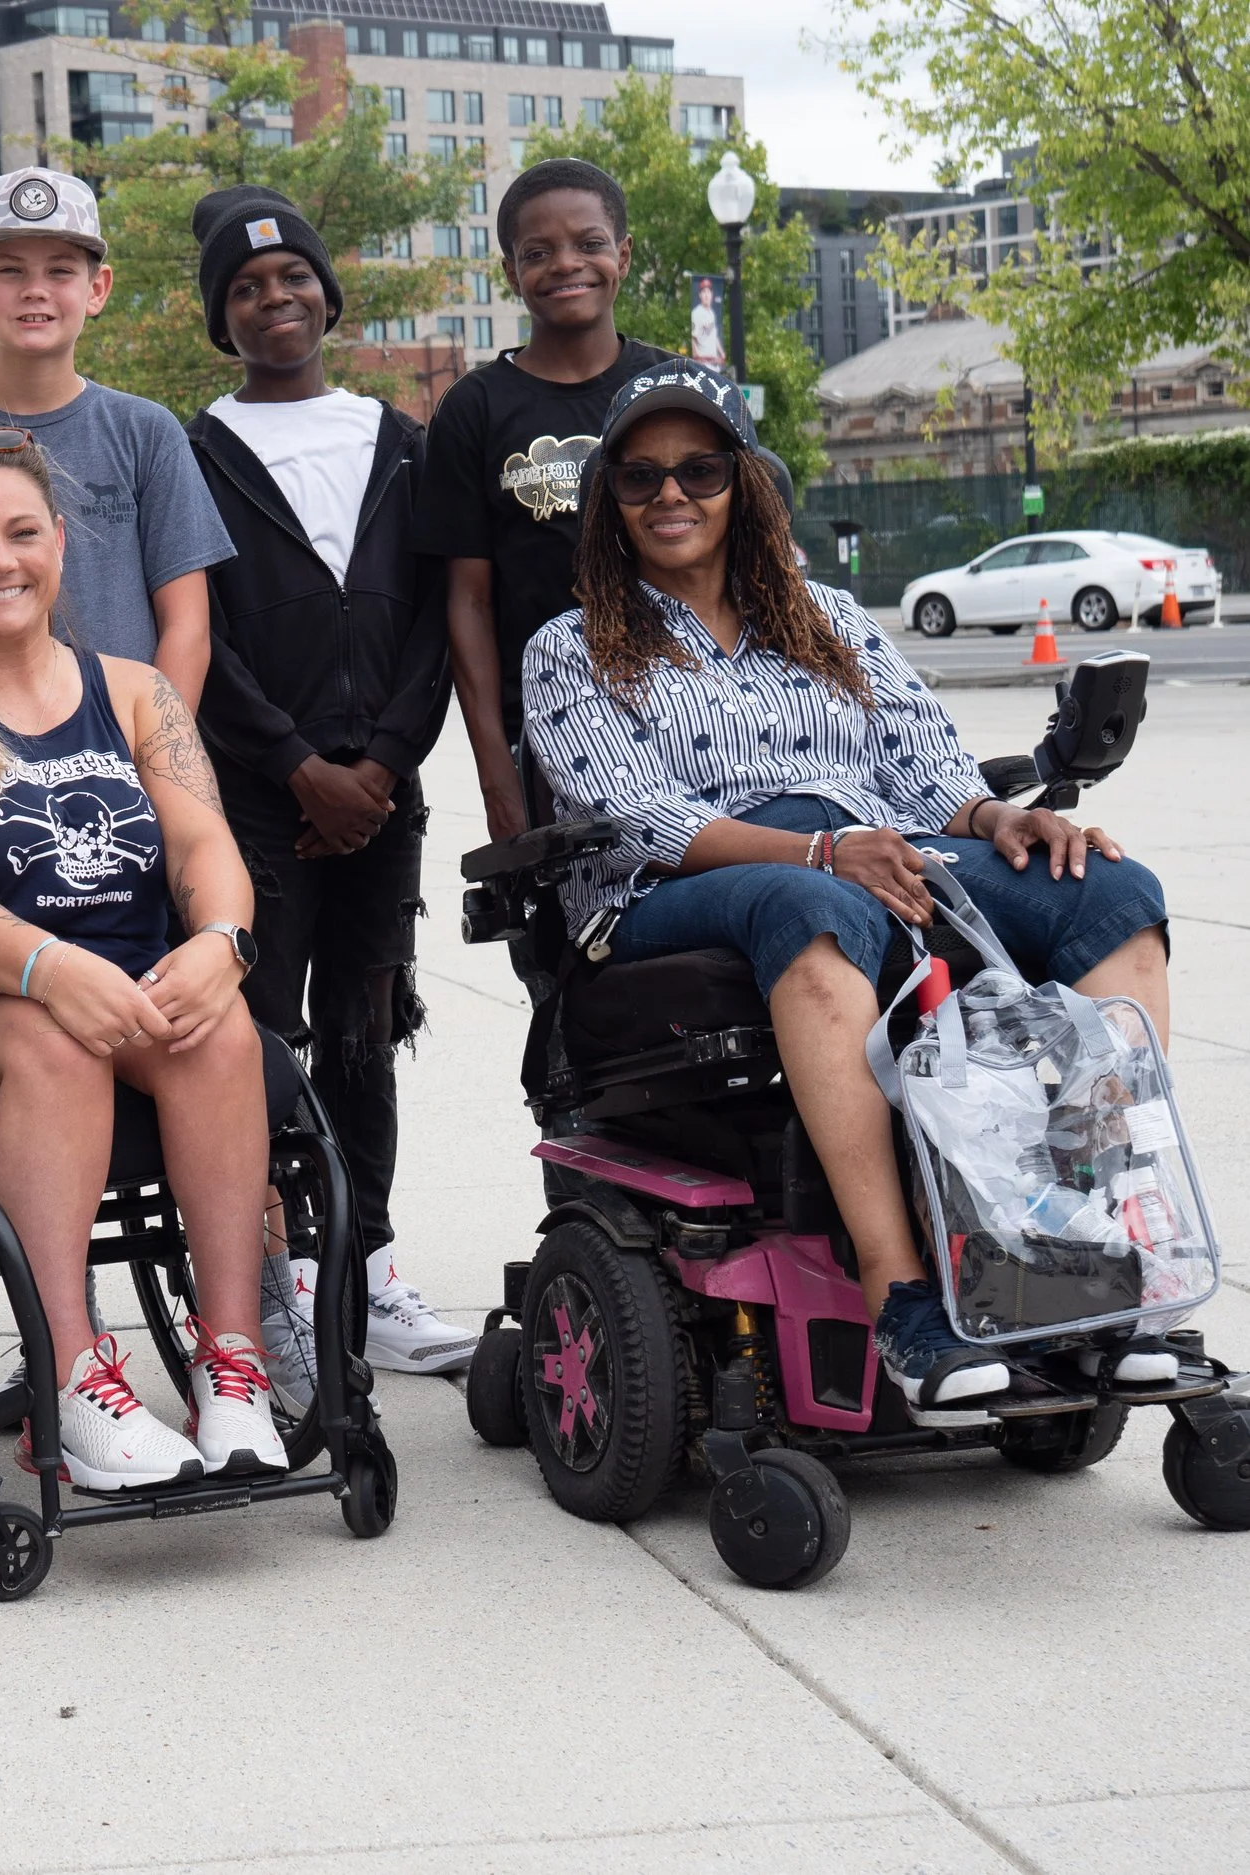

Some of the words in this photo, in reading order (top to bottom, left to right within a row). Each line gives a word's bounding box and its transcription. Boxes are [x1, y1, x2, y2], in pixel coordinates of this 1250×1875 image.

[631, 371, 731, 406] SEXY
[543, 460, 579, 481] FOR
[552, 479, 580, 490] UNMA
[36, 891, 132, 907] SPORTFISHING
